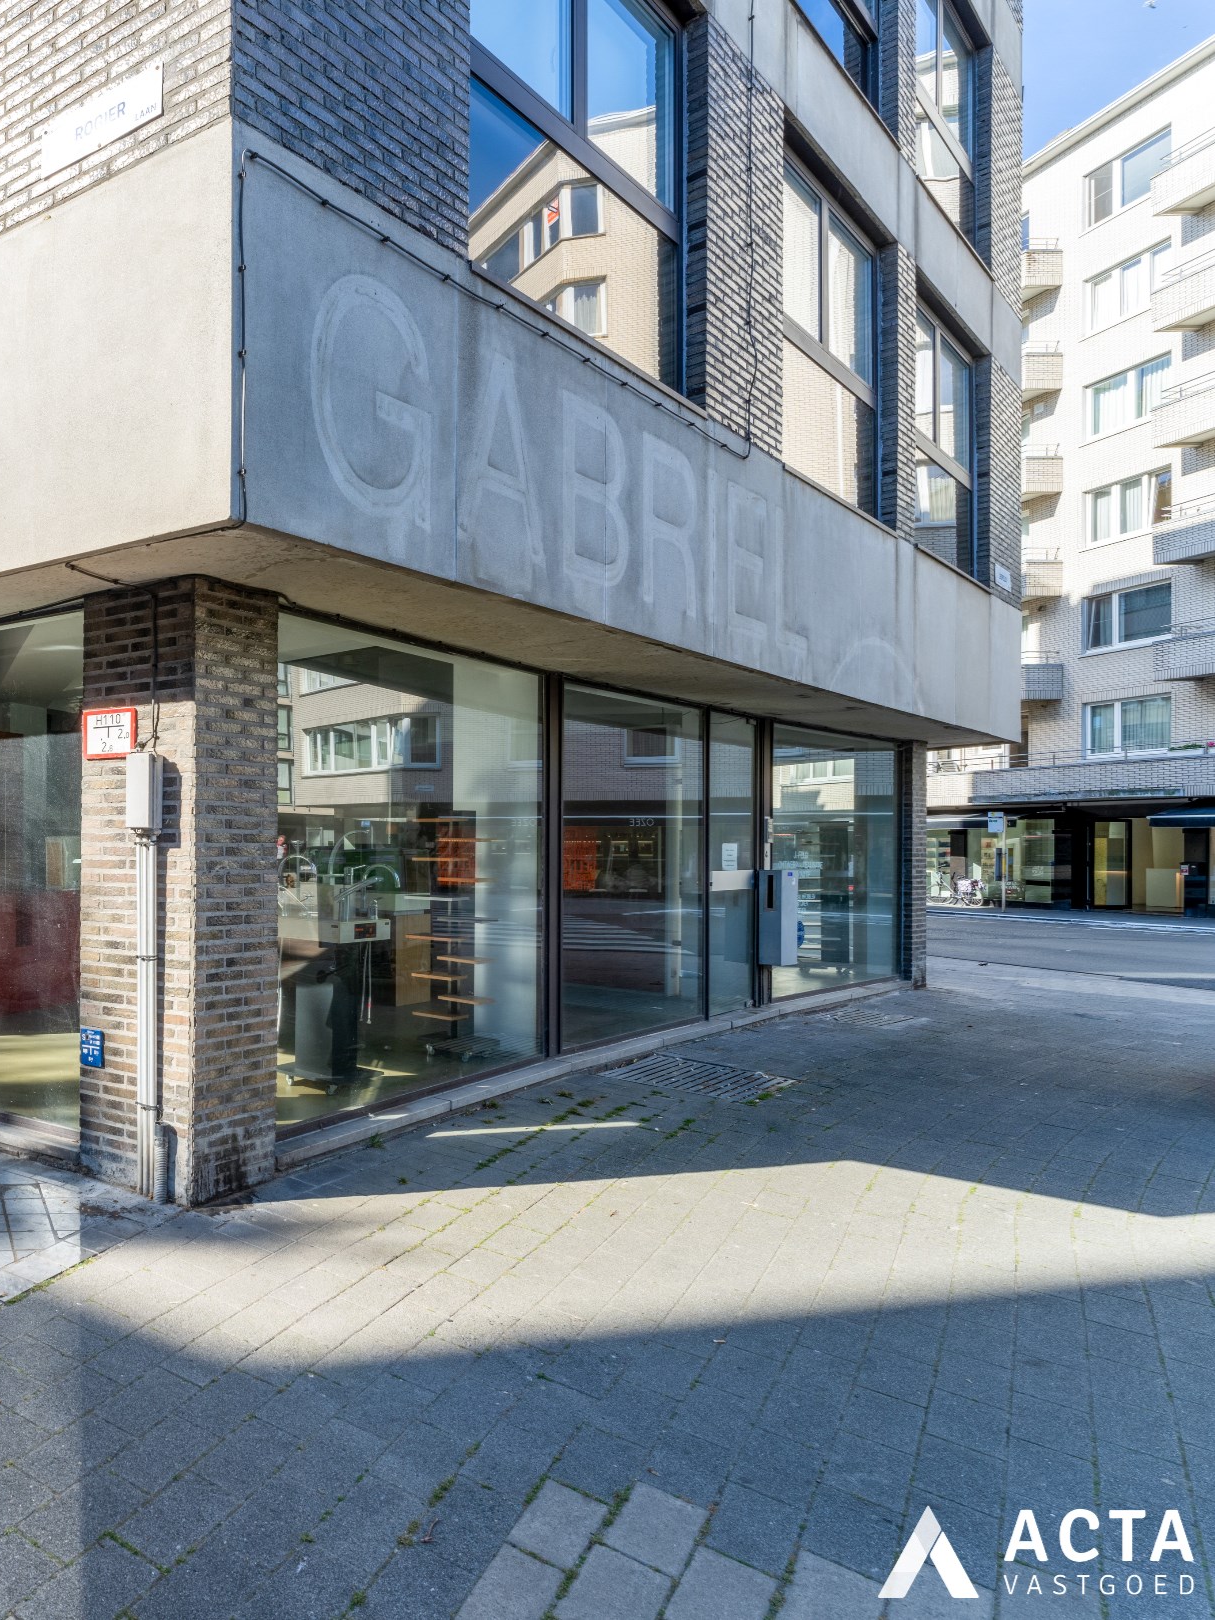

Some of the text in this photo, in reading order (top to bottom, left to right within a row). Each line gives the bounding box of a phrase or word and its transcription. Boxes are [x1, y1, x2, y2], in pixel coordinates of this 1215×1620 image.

[74, 101, 157, 141] ROGIER LAAN
[310, 273, 808, 653] GABRIEL
[95, 713, 121, 726] H110
